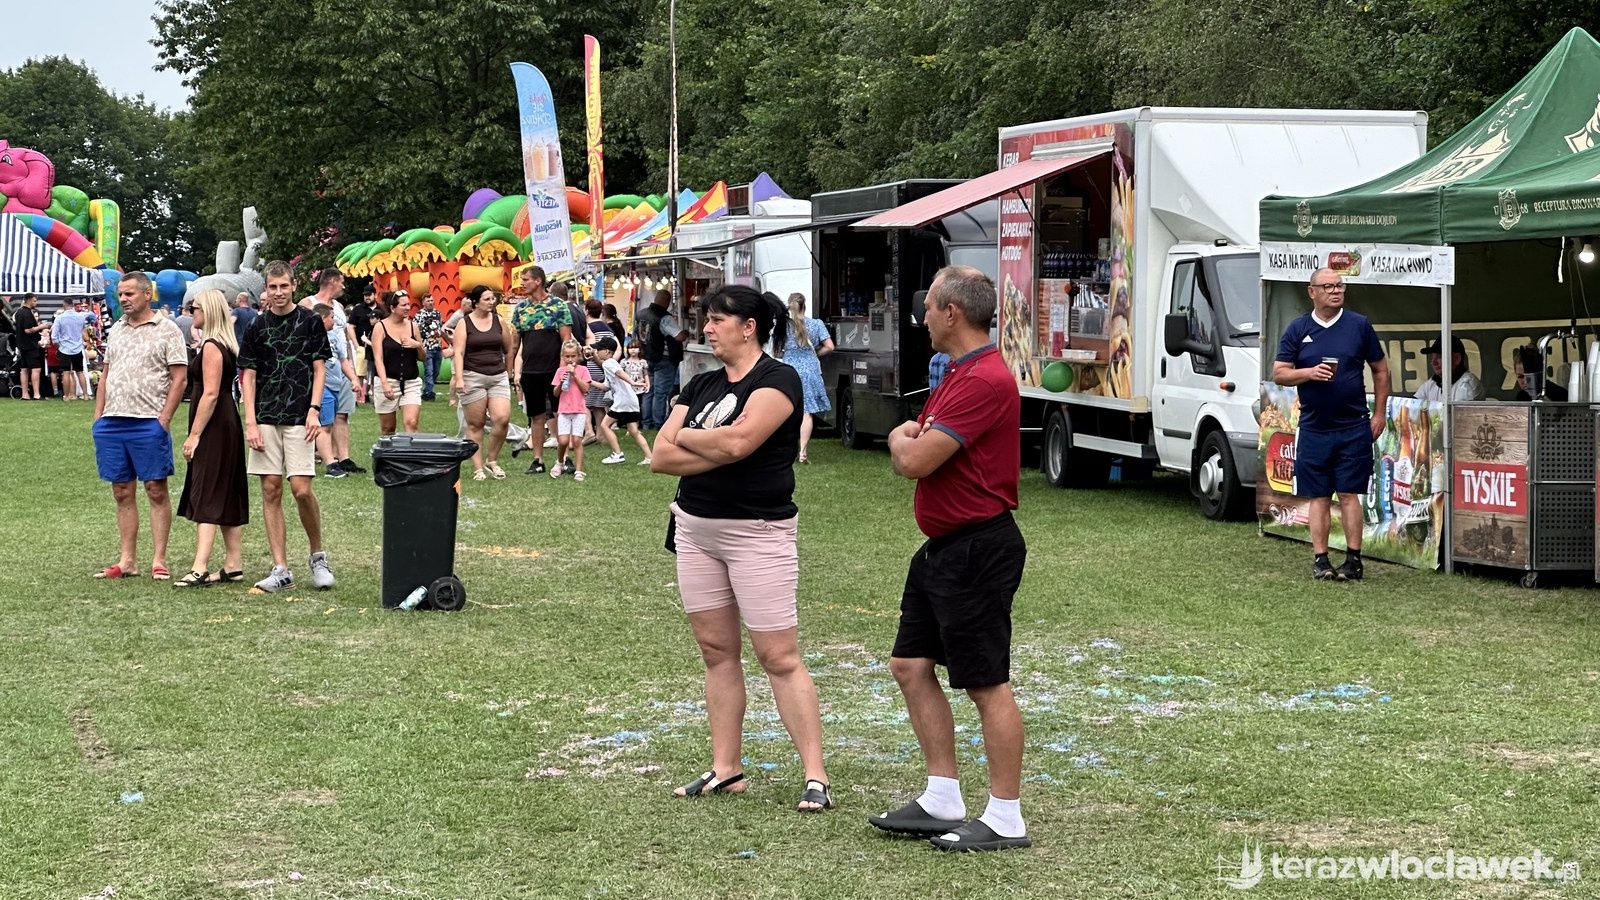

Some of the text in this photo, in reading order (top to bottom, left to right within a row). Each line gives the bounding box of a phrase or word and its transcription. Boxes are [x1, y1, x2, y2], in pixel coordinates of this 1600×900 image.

[1534, 199, 1571, 213] RECEPTURA
[1571, 197, 1600, 210] BROWAR
[1322, 214, 1350, 225] RECEPTURA
[1350, 215, 1375, 225] BROWARU
[1268, 253, 1288, 269] KASA
[1289, 254, 1299, 269] NA
[1300, 254, 1319, 270] PIWO
[1371, 256, 1391, 273] KASA
[1393, 257, 1406, 273] NA
[1407, 257, 1433, 274] PIWO
[1383, 470, 1391, 511] LECH
[1461, 469, 1517, 507] TYSKIE
